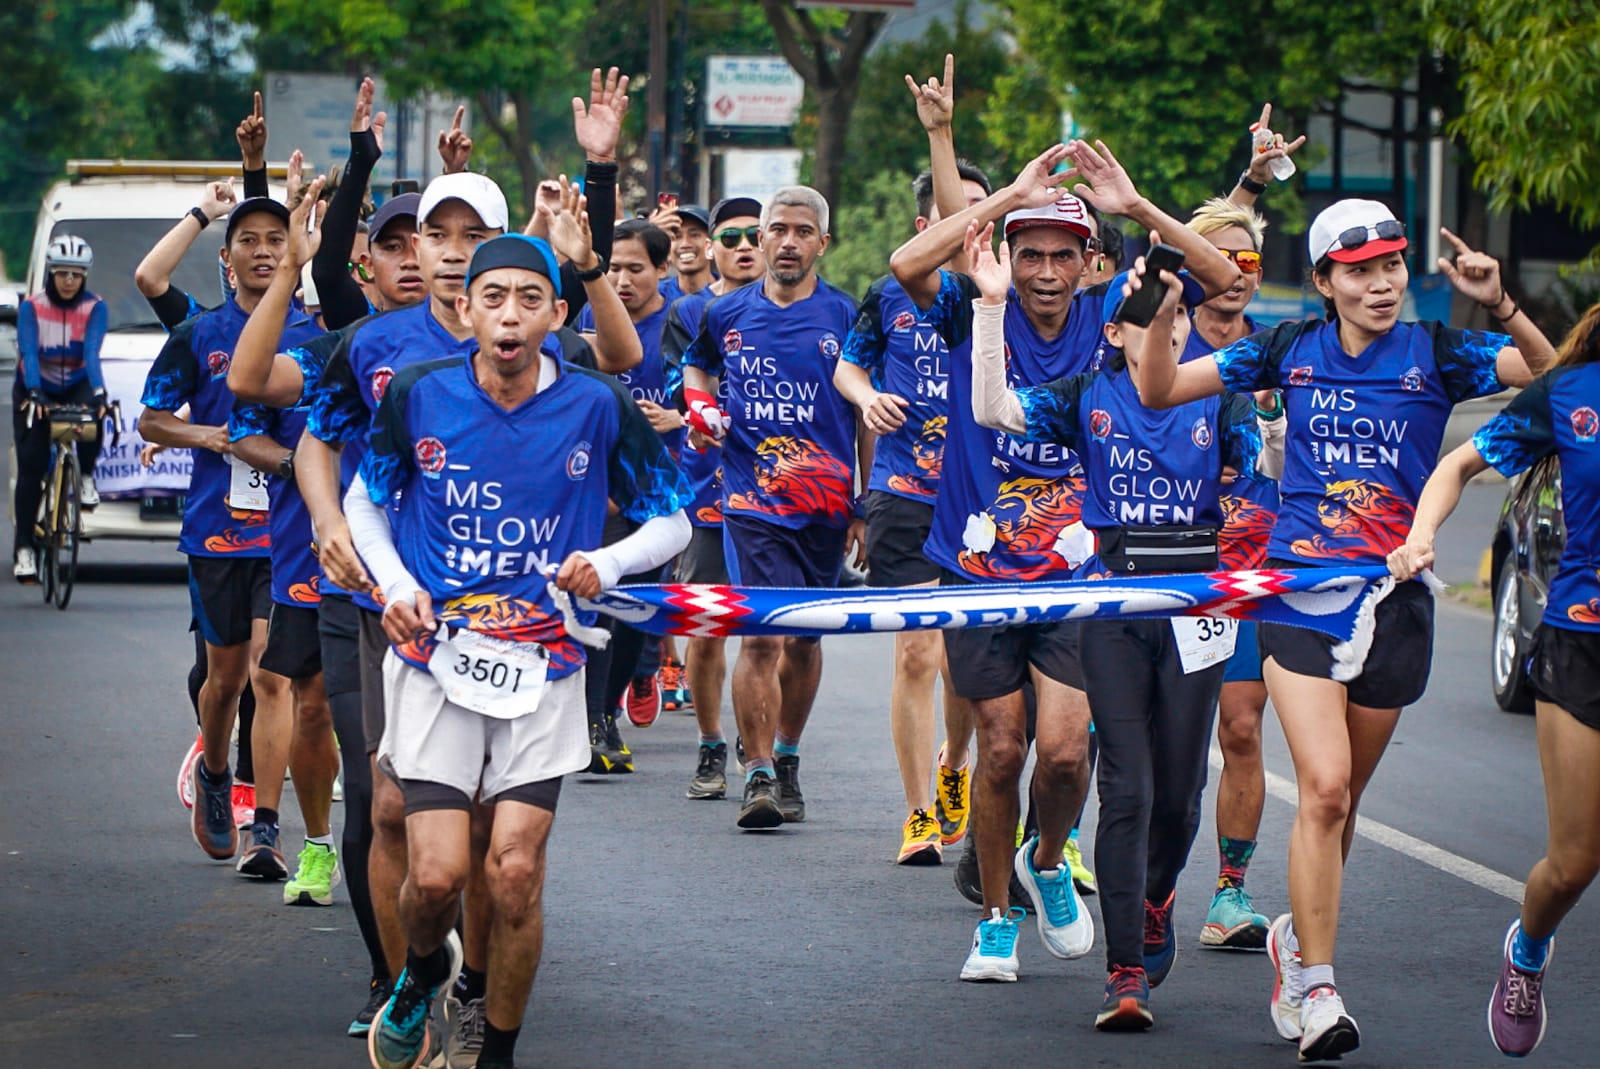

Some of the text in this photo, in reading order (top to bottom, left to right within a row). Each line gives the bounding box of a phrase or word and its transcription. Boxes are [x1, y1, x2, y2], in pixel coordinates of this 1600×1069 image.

[615, 369, 632, 385] S
[741, 356, 777, 376] MS
[914, 356, 949, 377] GL
[631, 387, 666, 404] OW
[744, 379, 819, 401] GLOW
[1311, 388, 1356, 411] MS
[755, 402, 814, 422] MEN
[1309, 414, 1408, 443] GLOW
[1110, 445, 1153, 471] MS
[1310, 442, 1399, 470] FOR MEN
[93, 463, 140, 479] INISH
[446, 479, 502, 510] MS
[1109, 473, 1203, 501] GLOW
[1120, 501, 1194, 525] MEN
[448, 514, 561, 546] GLOW
[460, 548, 549, 577] MEN
[453, 652, 523, 692] 3501
